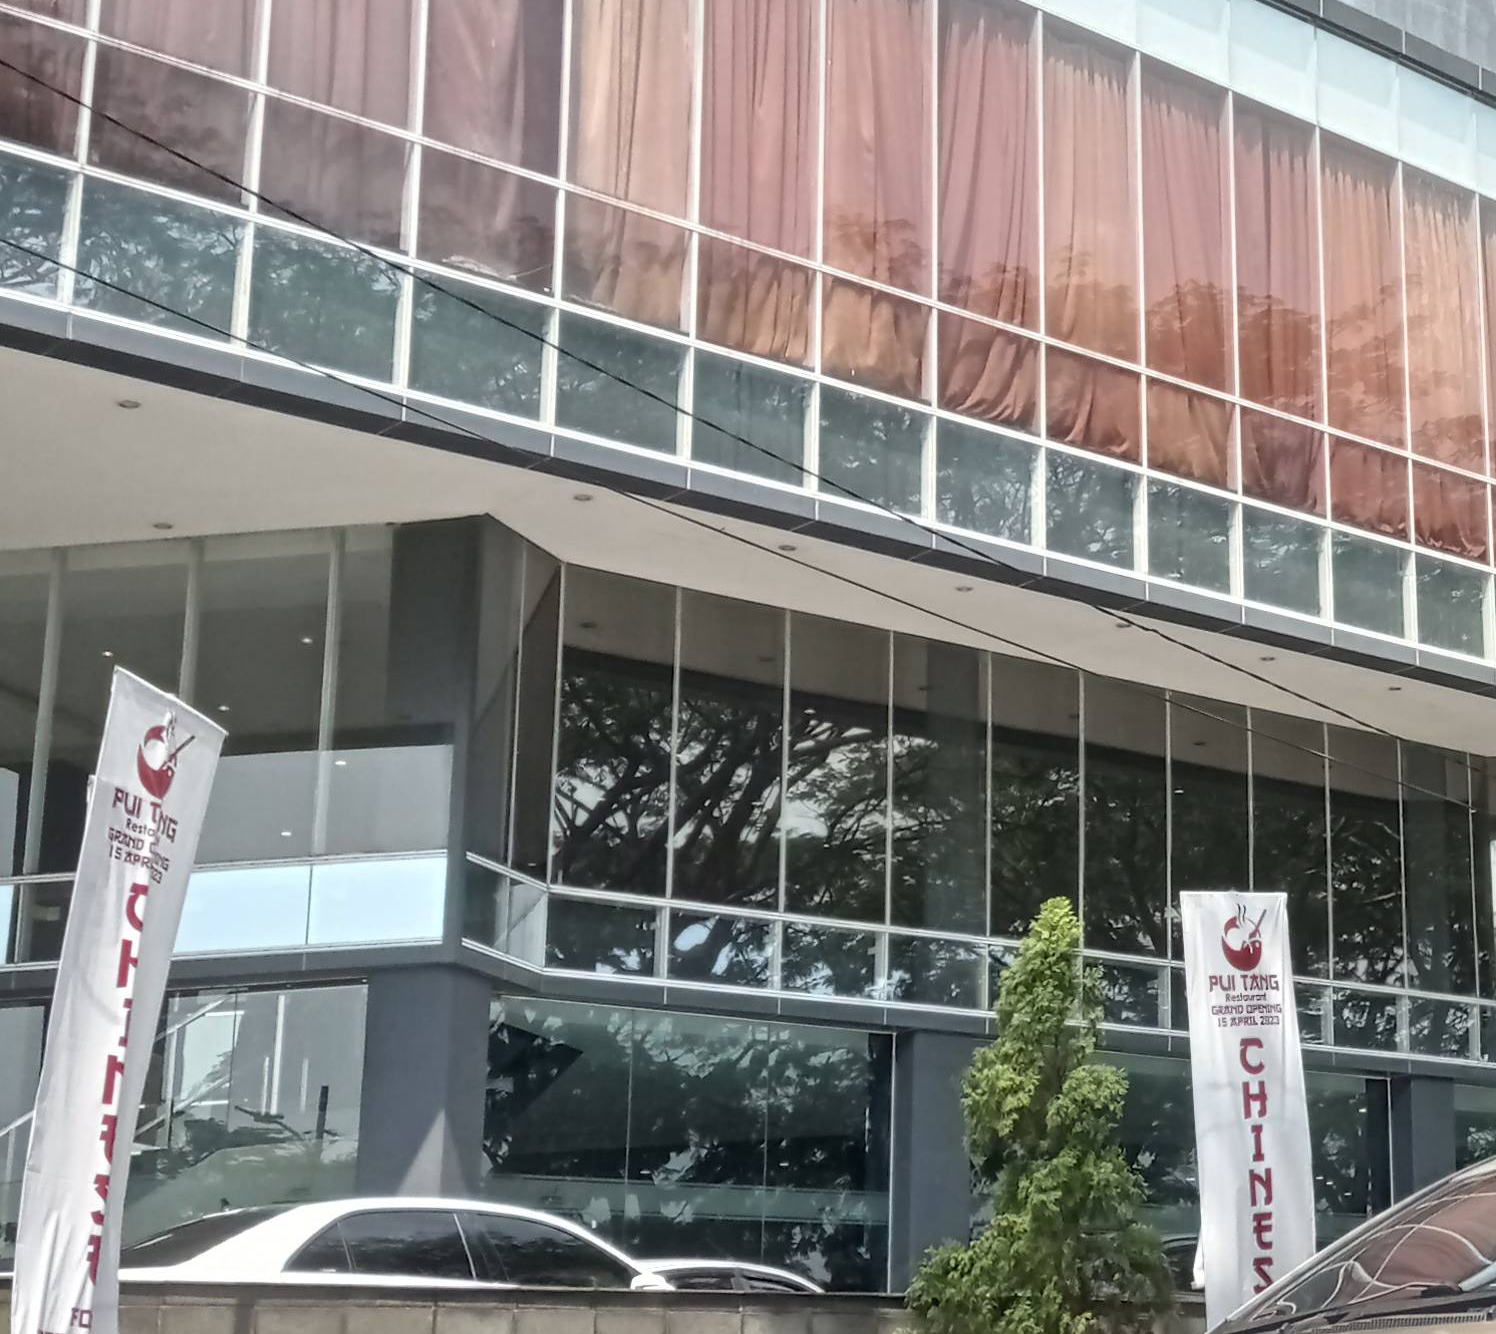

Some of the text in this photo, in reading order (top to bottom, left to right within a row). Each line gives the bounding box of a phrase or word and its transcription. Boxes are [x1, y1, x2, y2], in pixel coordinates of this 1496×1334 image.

[112, 787, 178, 843] PUI TNG
[1208, 974, 1280, 992] PUI TANG
[1225, 992, 1267, 1002] Restaurant
[1211, 1003, 1282, 1015] GRAND OPENING
[1217, 1015, 1280, 1027] 15 APRIL 2023
